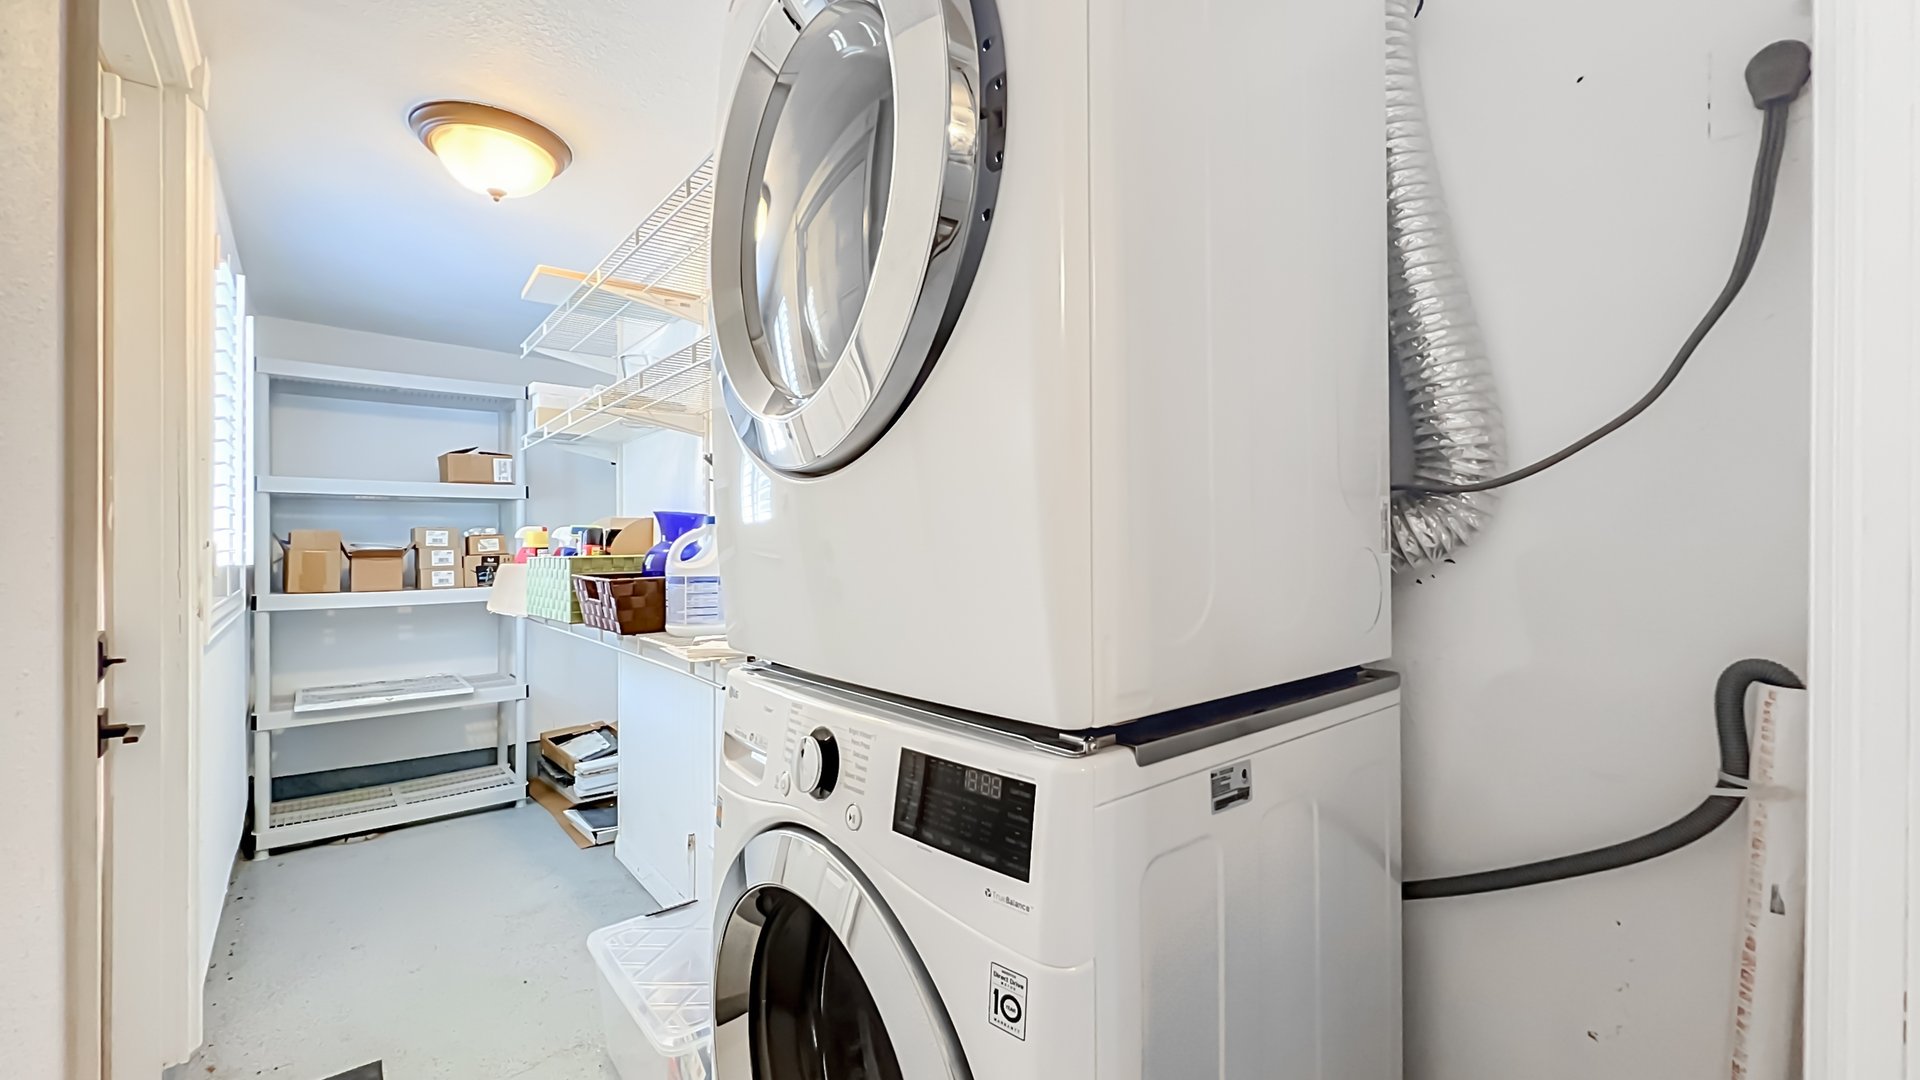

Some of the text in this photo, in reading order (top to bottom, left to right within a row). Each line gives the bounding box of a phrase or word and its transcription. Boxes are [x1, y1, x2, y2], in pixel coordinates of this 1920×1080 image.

[993, 970, 1009, 983] Direct
[1010, 977, 1024, 990] Drive
[993, 988, 1022, 1023] 10
